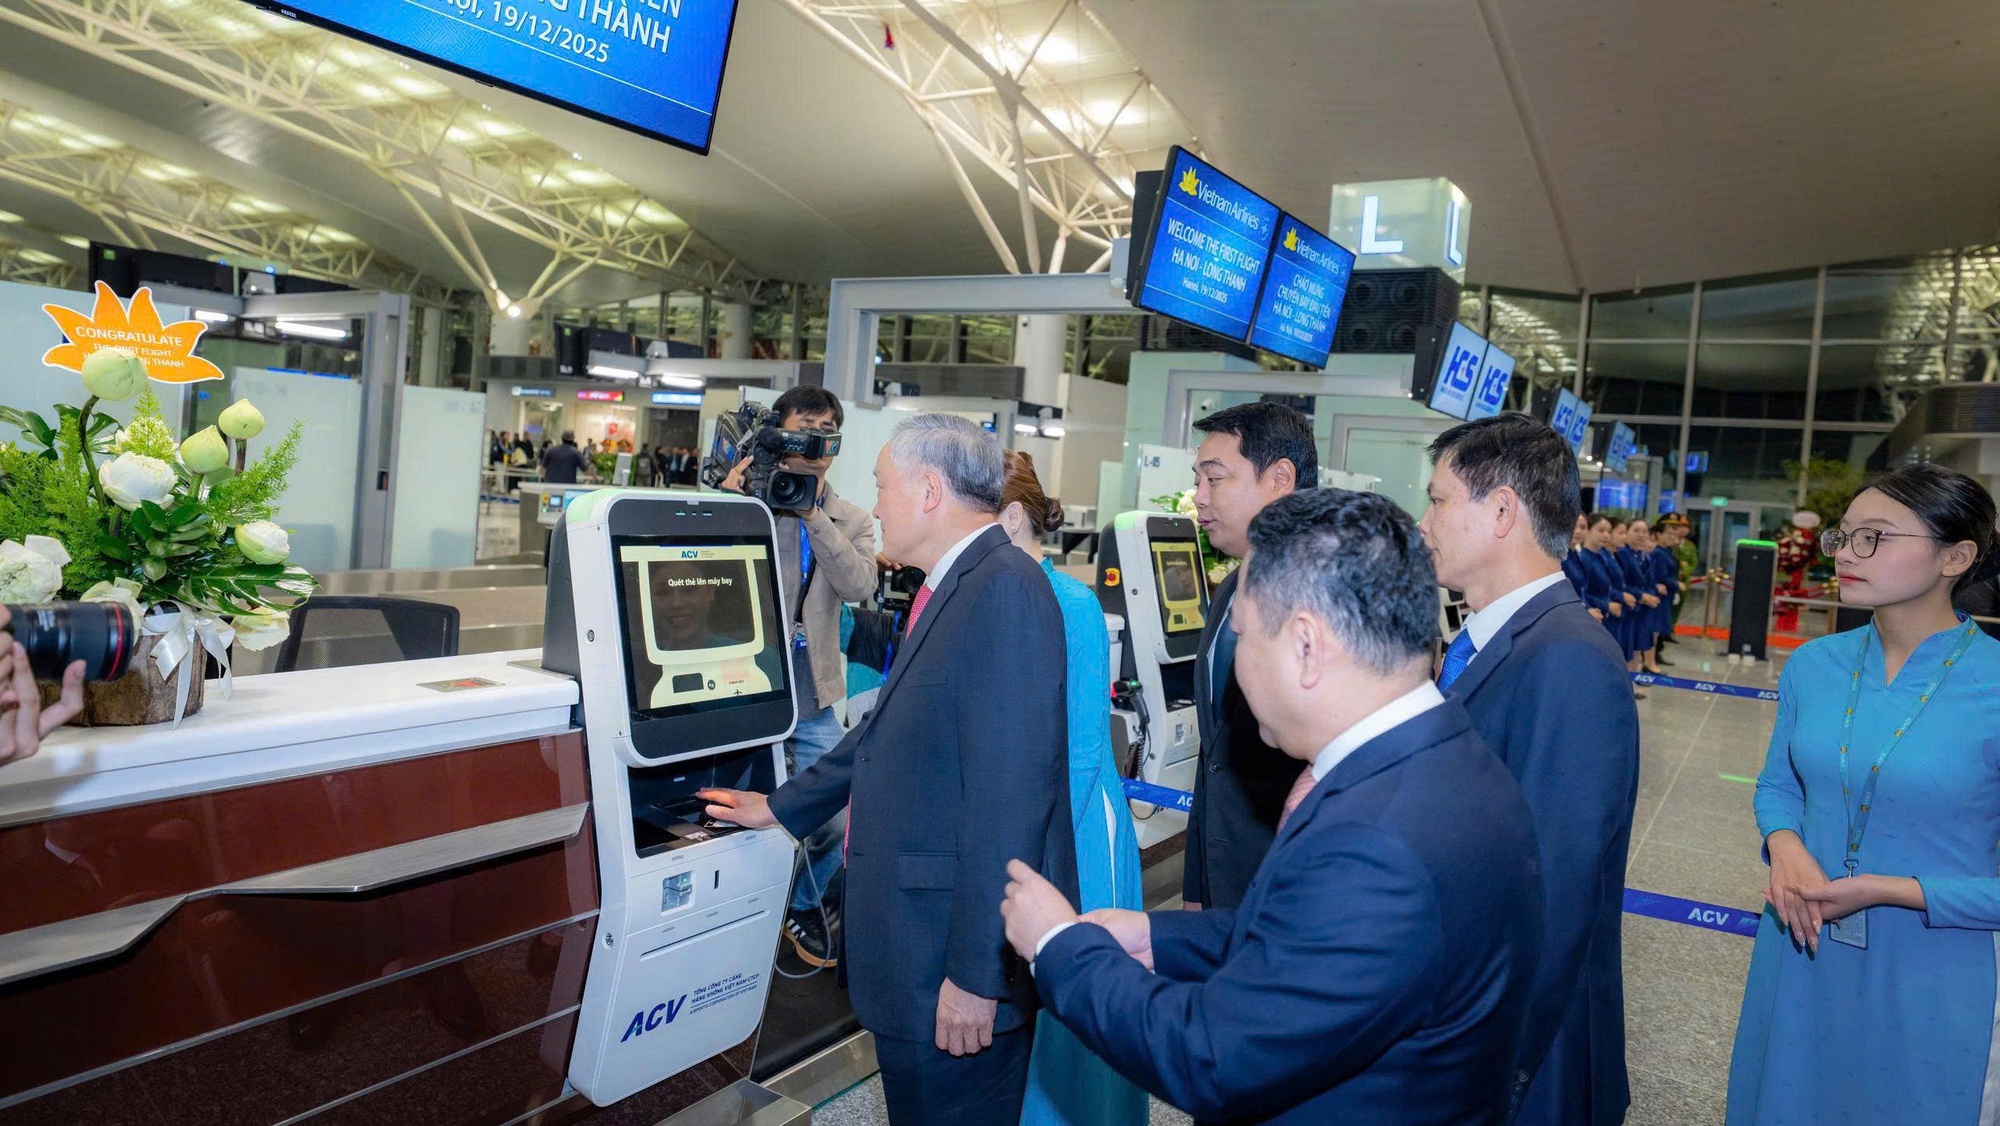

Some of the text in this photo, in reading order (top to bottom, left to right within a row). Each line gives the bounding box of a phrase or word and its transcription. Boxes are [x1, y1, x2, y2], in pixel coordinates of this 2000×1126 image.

[493, 1, 610, 63] 19/12/2025
[1361, 195, 1403, 254] L
[1168, 217, 1260, 275] WELCOME THE FIRST FLIGHT
[1172, 246, 1184, 266] HA
[1184, 252, 1200, 272] NOI
[1202, 261, 1224, 282] LONG
[1223, 269, 1247, 293] THANH
[76, 326, 183, 347] CONGRATULATE
[141, 347, 173, 357] FLIGHT
[153, 359, 185, 368] THANH
[681, 550, 699, 559] ACV
[668, 576, 733, 587] Quét thẻ lên máy bay
[1634, 674, 1655, 683] ACV
[1694, 682, 1717, 692] ACV
[1757, 690, 1780, 700] ACV
[1177, 795, 1194, 807] AC
[1687, 907, 1730, 926] ACV
[620, 994, 688, 1043] ACV
